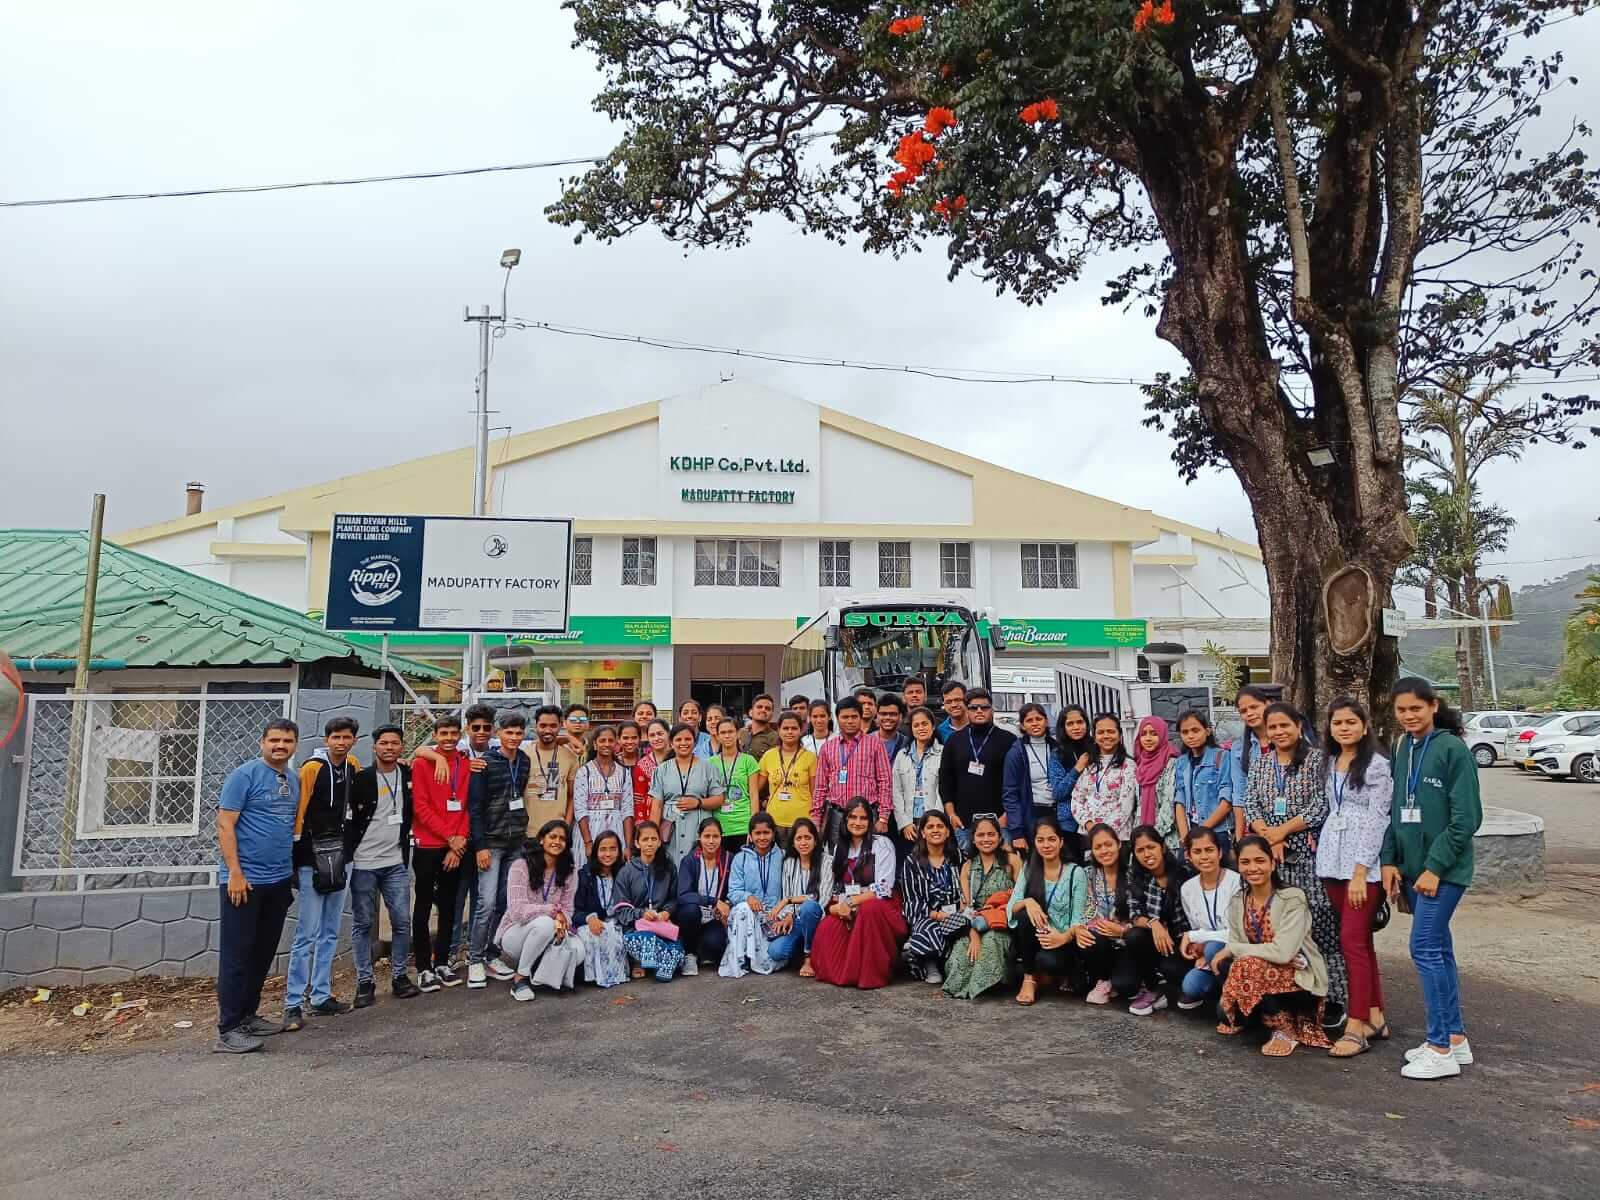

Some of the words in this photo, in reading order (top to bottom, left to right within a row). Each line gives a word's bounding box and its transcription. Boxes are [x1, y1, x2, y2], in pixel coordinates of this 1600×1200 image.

[670, 456, 714, 471] KDHP
[681, 488, 743, 503] MADUPATTY
[748, 490, 795, 504] FACTORY
[363, 517, 387, 525] DEVAN
[388, 518, 407, 526] HILLS
[336, 525, 379, 533] PLANTATIONS
[381, 526, 413, 534] COMPANY
[336, 532, 362, 540] PRIVATE
[363, 533, 390, 541] LIMITED
[348, 569, 396, 586] Ripple
[427, 577, 502, 589] MADUPATTY
[505, 578, 561, 590] FACTORY
[844, 611, 968, 627] SURYA
